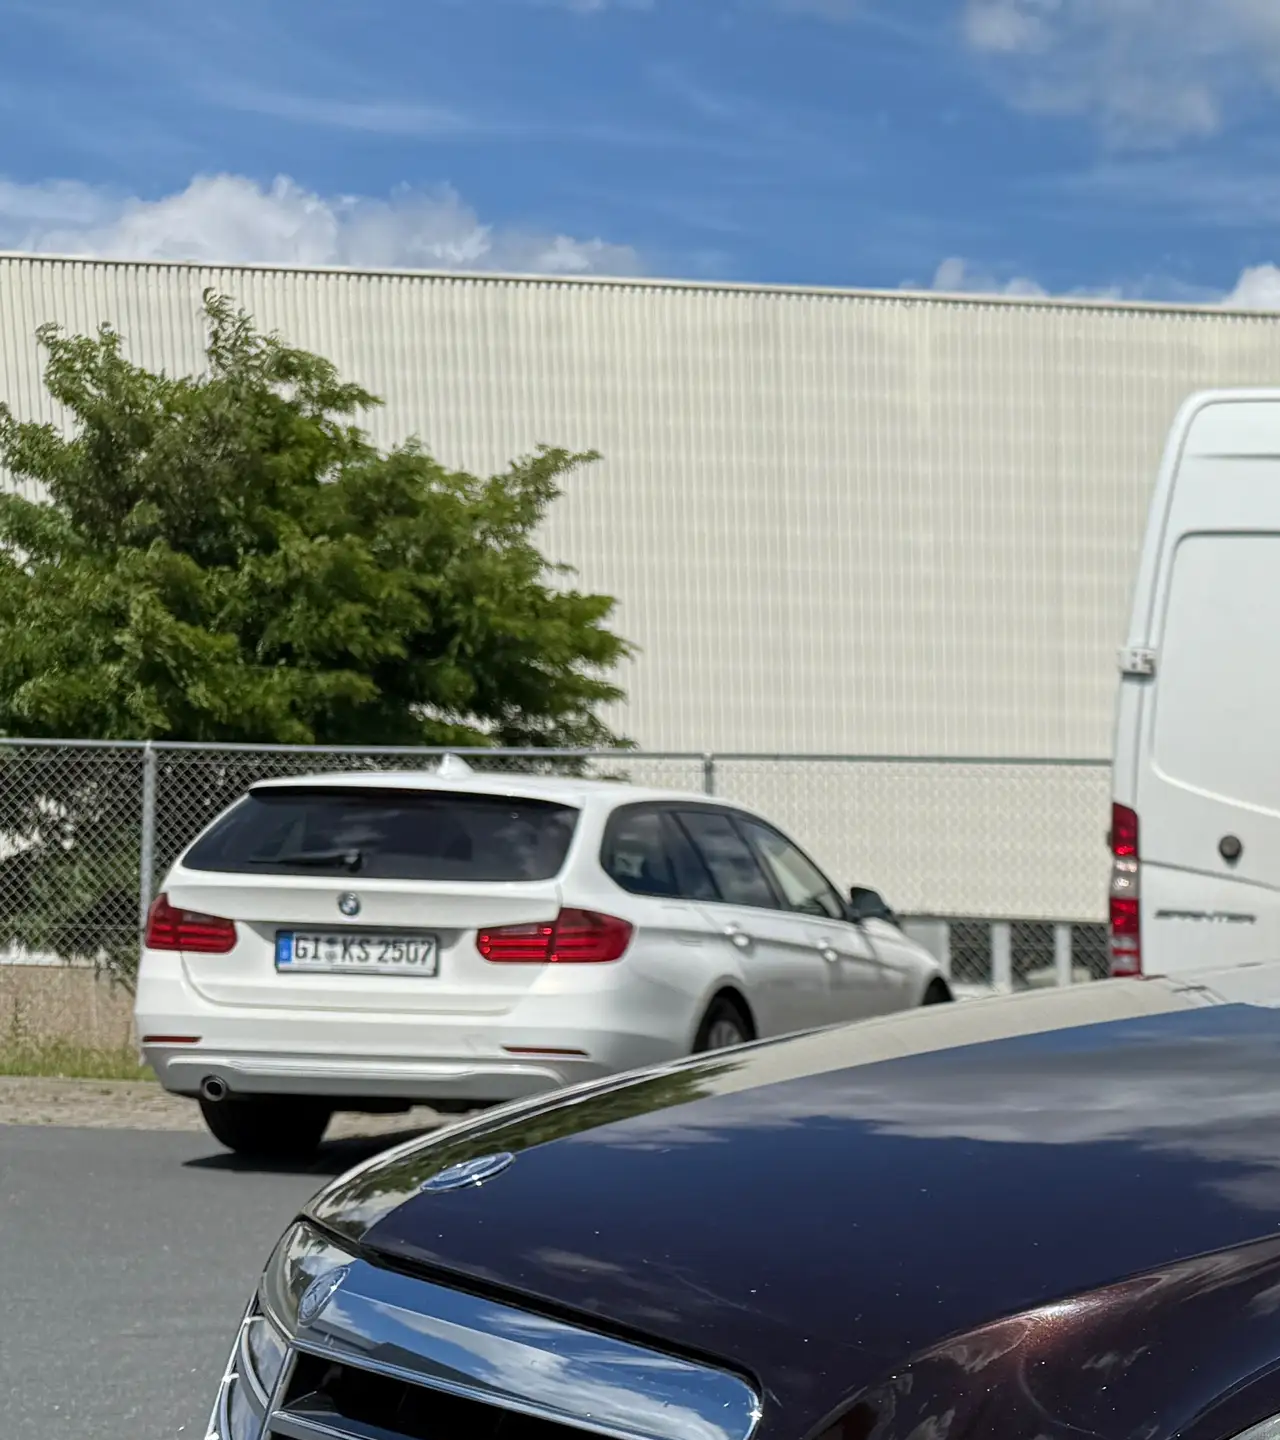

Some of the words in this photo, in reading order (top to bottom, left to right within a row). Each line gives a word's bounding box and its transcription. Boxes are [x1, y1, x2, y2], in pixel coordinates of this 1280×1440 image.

[295, 935, 321, 960] GI
[341, 937, 371, 962] KS
[377, 939, 432, 966] 2507
